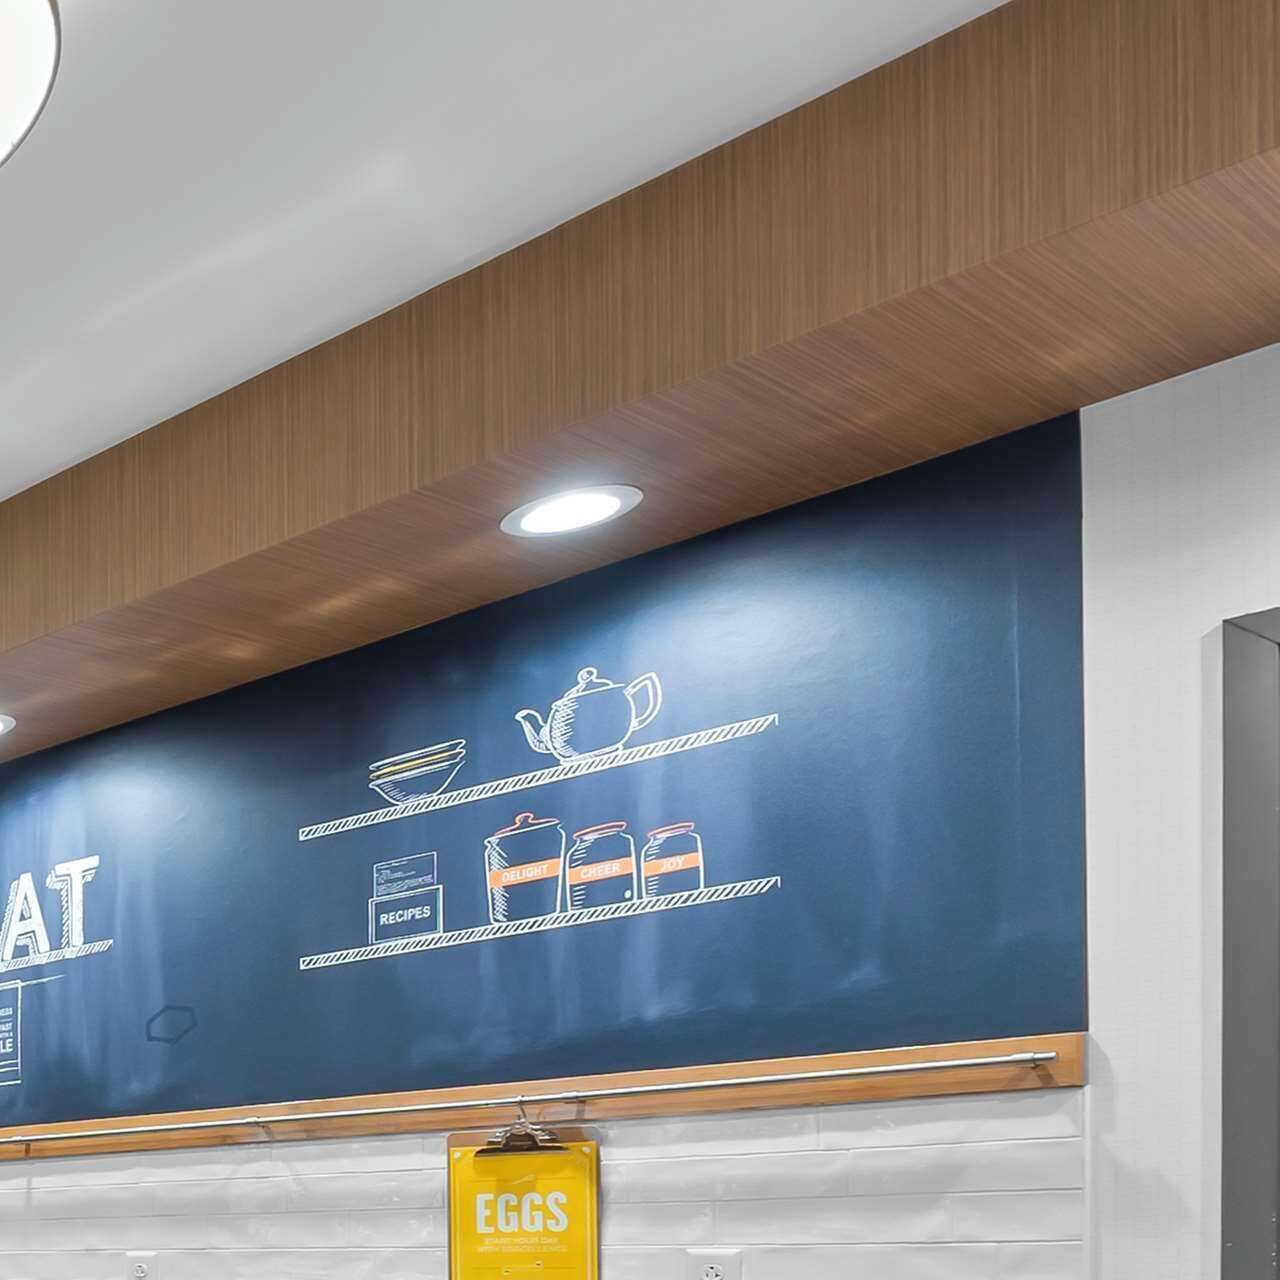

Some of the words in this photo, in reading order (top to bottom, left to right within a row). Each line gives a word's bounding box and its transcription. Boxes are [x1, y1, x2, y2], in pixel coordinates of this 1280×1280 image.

[501, 864, 548, 883] DELIGHT
[580, 862, 621, 879] CHEER
[660, 856, 686, 872] JOY
[379, 905, 432, 926] RECIPES
[476, 1191, 569, 1234] EGGS
